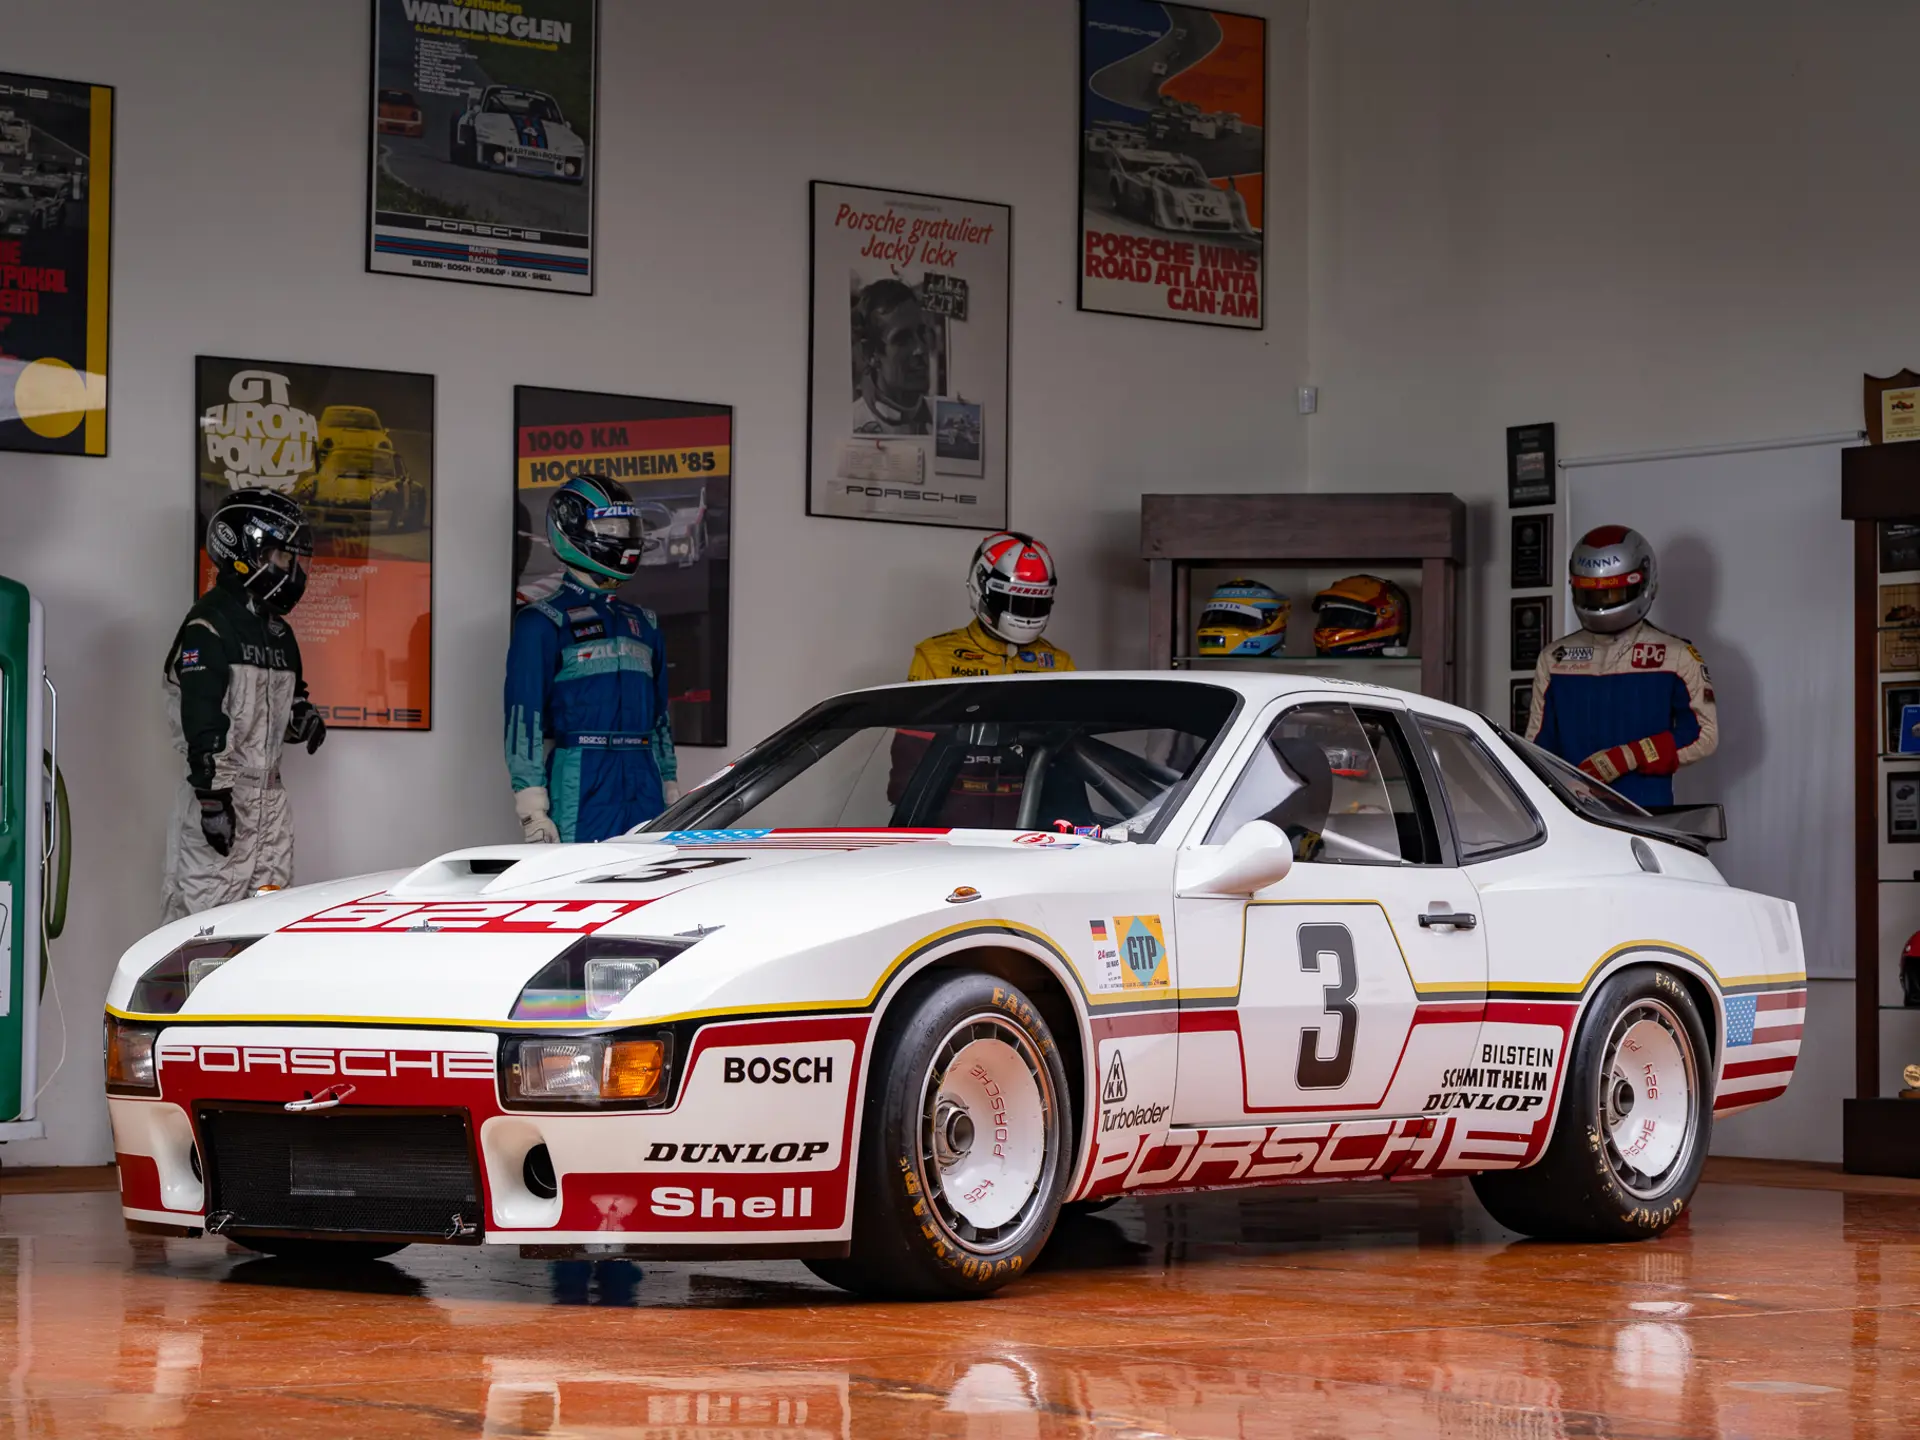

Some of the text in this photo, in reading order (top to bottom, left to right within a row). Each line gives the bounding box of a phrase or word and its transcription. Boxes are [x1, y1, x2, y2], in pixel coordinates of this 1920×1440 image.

[402, 0, 572, 44] WATKINS GLEN
[425, 218, 542, 241] PORSCHE
[834, 203, 995, 246] Porsche gratuliert
[861, 233, 958, 269] Jacky Ickx
[1086, 230, 1258, 272] PORSCHE WINS
[447, 262, 472, 273] BOSCH
[475, 266, 506, 277] DUNLOP
[1086, 254, 1258, 296] ROAD ATLANTA
[228, 369, 292, 406] GT
[204, 402, 320, 442] EUROPA
[206, 434, 316, 476] POKAL
[527, 426, 630, 452] 1000 KM
[531, 453, 678, 483] HOCKENHEIM
[846, 485, 978, 505] PORSCHE
[594, 505, 642, 519] FALKE
[1577, 555, 1621, 569] HANNA
[1633, 644, 1666, 666] PPG
[951, 666, 979, 677] Mobil
[294, 899, 632, 930] 924
[1126, 935, 1158, 971] GTP
[991, 986, 1057, 1058] EAGLE
[1294, 921, 1360, 1092] 3
[156, 1046, 495, 1079] PORSCHE
[724, 1056, 833, 1084] BOSCH
[1482, 1043, 1554, 1068] BILSTEIN
[1642, 1063, 1659, 1100] 924
[970, 1063, 1009, 1160] PORSCHE
[1101, 1102, 1170, 1133] Turbolader
[1422, 1092, 1544, 1113] DUNLOP
[643, 1141, 830, 1164] DUNLOP
[1078, 1117, 1534, 1199] PORSCHE
[650, 1186, 814, 1219] Shell
[963, 1178, 994, 1204] 924
